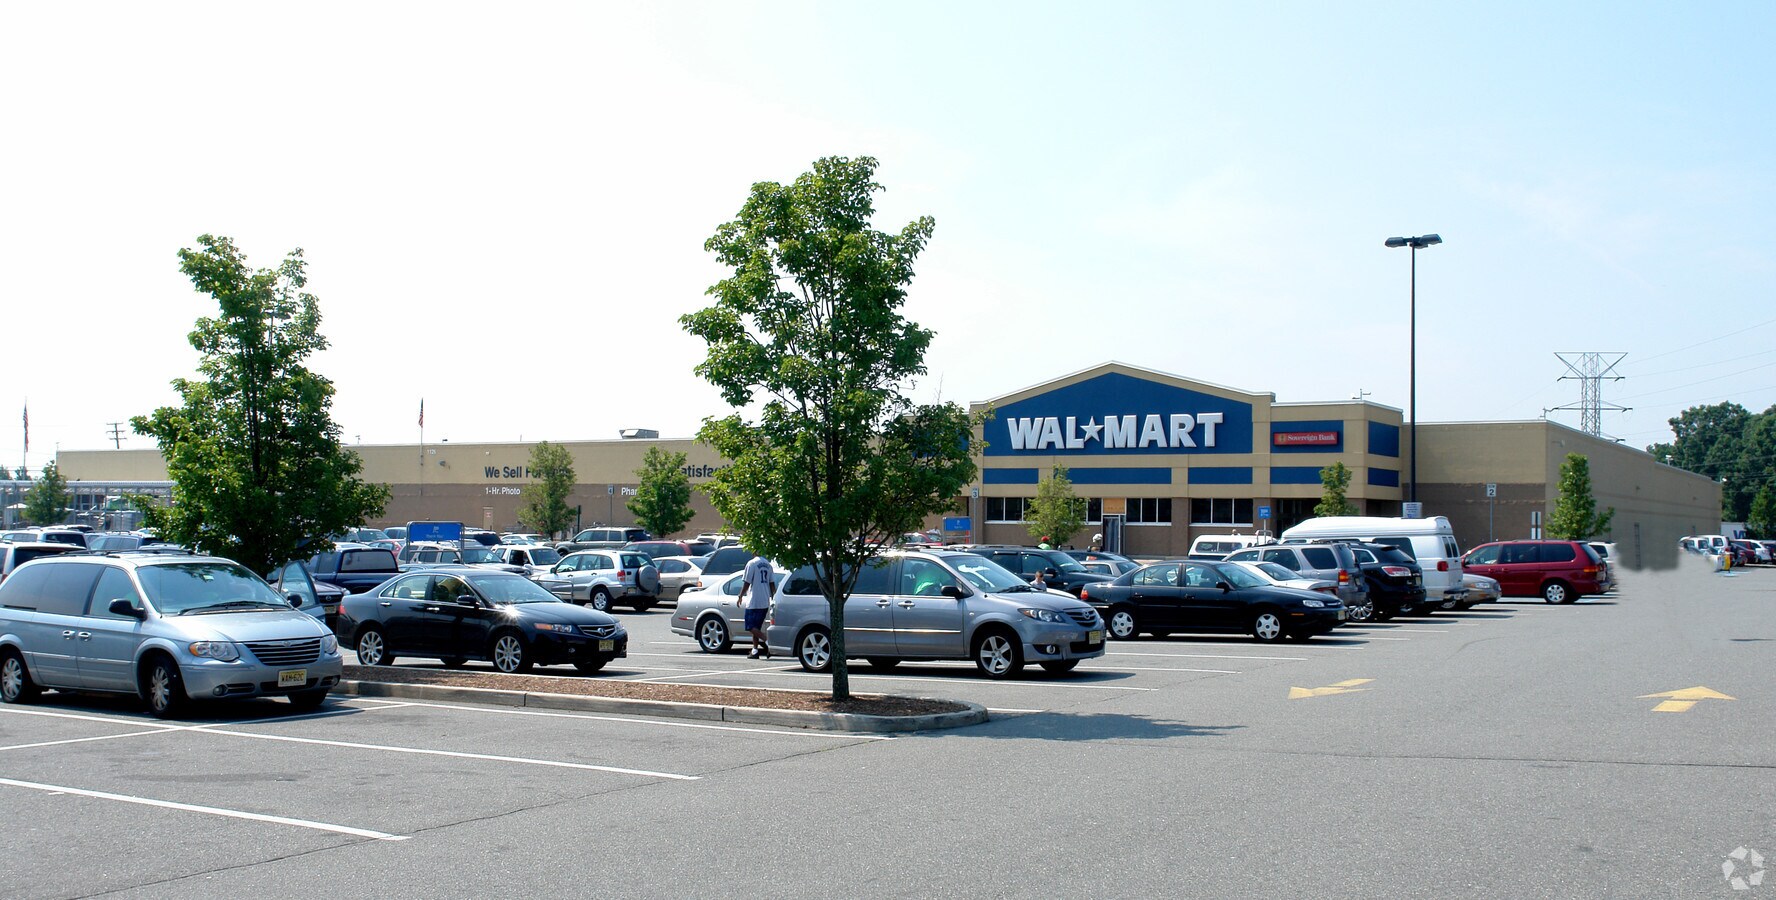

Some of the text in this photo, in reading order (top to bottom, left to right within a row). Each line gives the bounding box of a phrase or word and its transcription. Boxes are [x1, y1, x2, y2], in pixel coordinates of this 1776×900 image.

[1104, 412, 1224, 449] MART
[1287, 433, 1335, 443] Sovereign Bank
[484, 466, 500, 479] We
[503, 466, 522, 479] Sell
[485, 486, 521, 495] 1-Hr. Photo
[1489, 488, 1495, 496] 2
